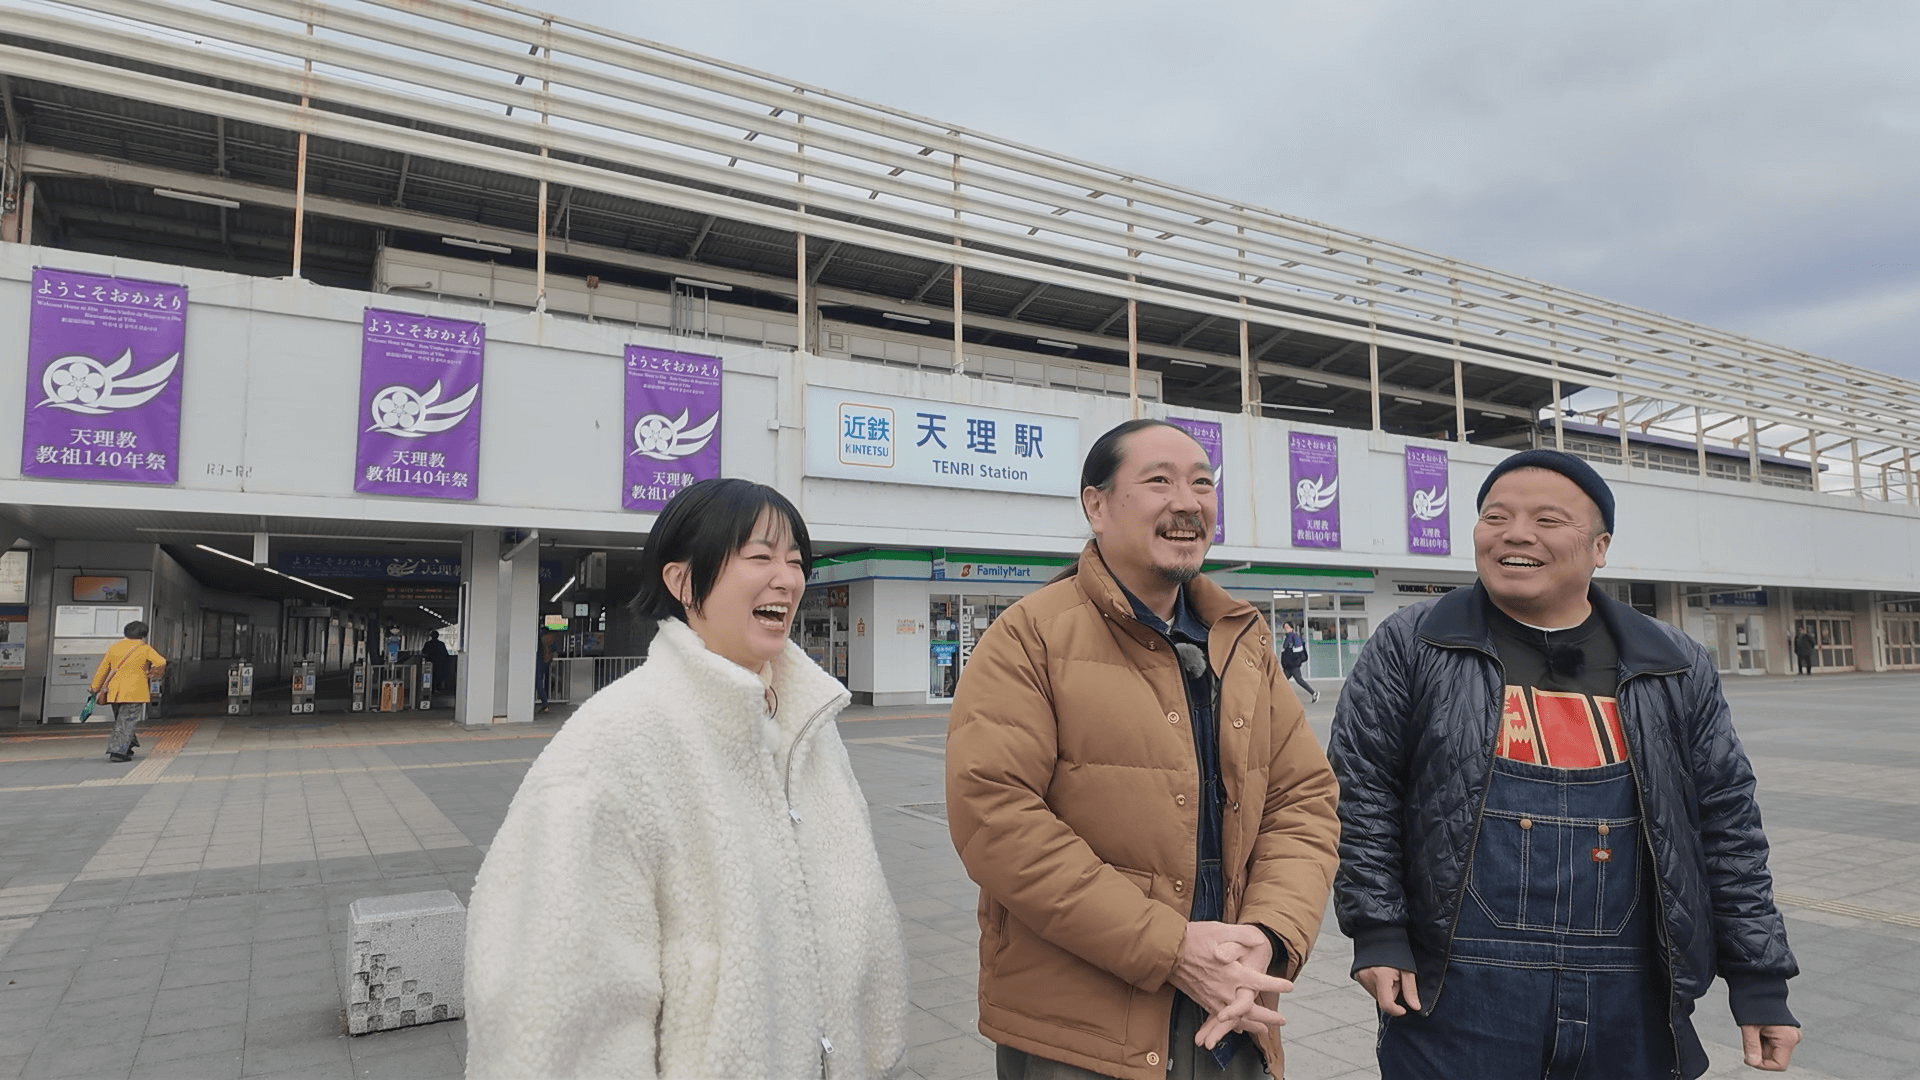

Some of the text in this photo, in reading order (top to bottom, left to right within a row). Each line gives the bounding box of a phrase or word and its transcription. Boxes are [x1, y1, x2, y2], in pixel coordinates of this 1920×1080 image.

[38, 280, 182, 310] ようこそおかえり
[367, 318, 480, 346] ようこそおかえり
[628, 353, 719, 378] ようこそおかえり
[844, 414, 890, 442] 近鉄
[916, 412, 1044, 459] 天理駅
[69, 428, 138, 449] 天理教
[1291, 436, 1337, 451] ようこそおかえり
[36, 445, 167, 471] 教祖140年祭
[845, 443, 889, 457] KINTETSU
[392, 450, 446, 469] 天理教
[365, 465, 469, 488] 教祖140年祭
[932, 459, 1028, 481] TENRI Station
[653, 471, 695, 487] 天理教
[631, 484, 681, 500] 教祖14
[1306, 519, 1329, 531] 天理教
[1421, 527, 1441, 538] 天理教
[1297, 529, 1338, 542] 教祖140年祭
[293, 556, 381, 567] ようこそおかえり
[977, 564, 1031, 579] FamilyMart
[231, 705, 237, 713] 5
[294, 704, 312, 712] 4 3
[354, 702, 361, 710] 3
